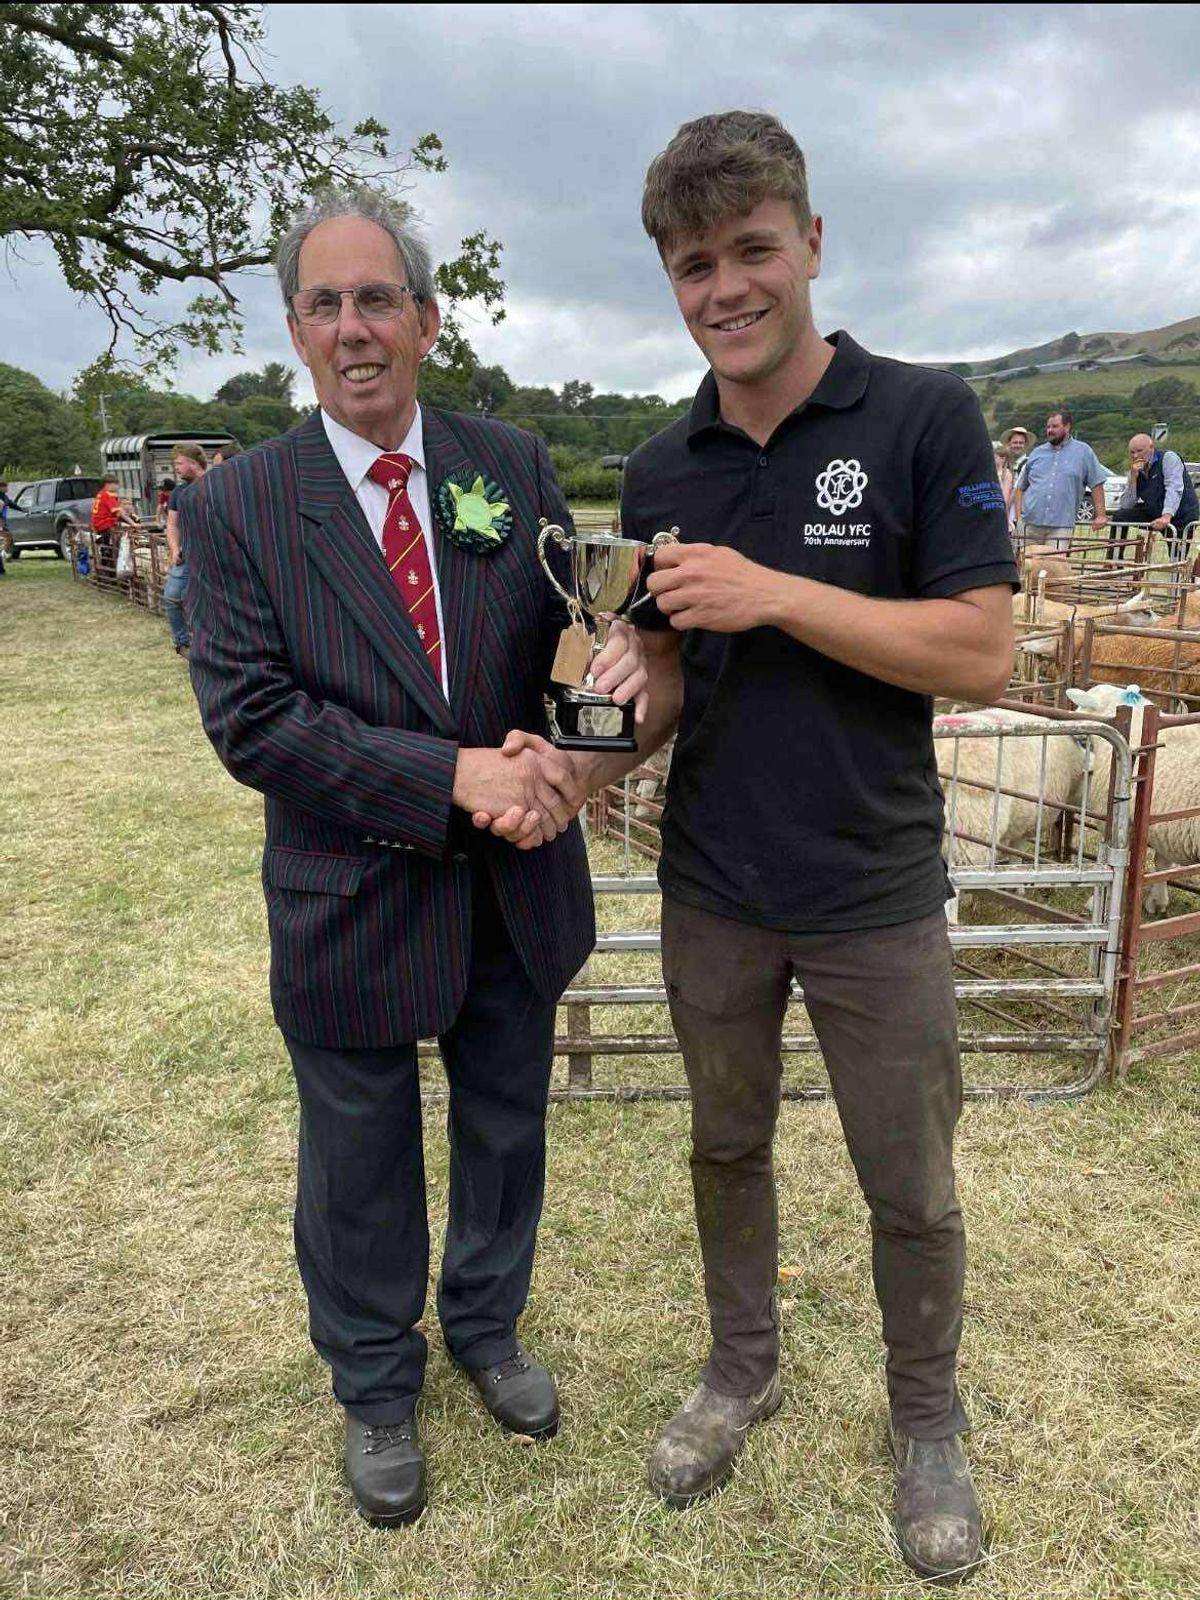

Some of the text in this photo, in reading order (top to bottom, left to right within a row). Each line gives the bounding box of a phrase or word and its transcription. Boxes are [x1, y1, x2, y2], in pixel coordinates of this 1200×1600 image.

[804, 524, 872, 536] DOLAU YFC
[803, 537, 871, 548] 70th Anniversary
